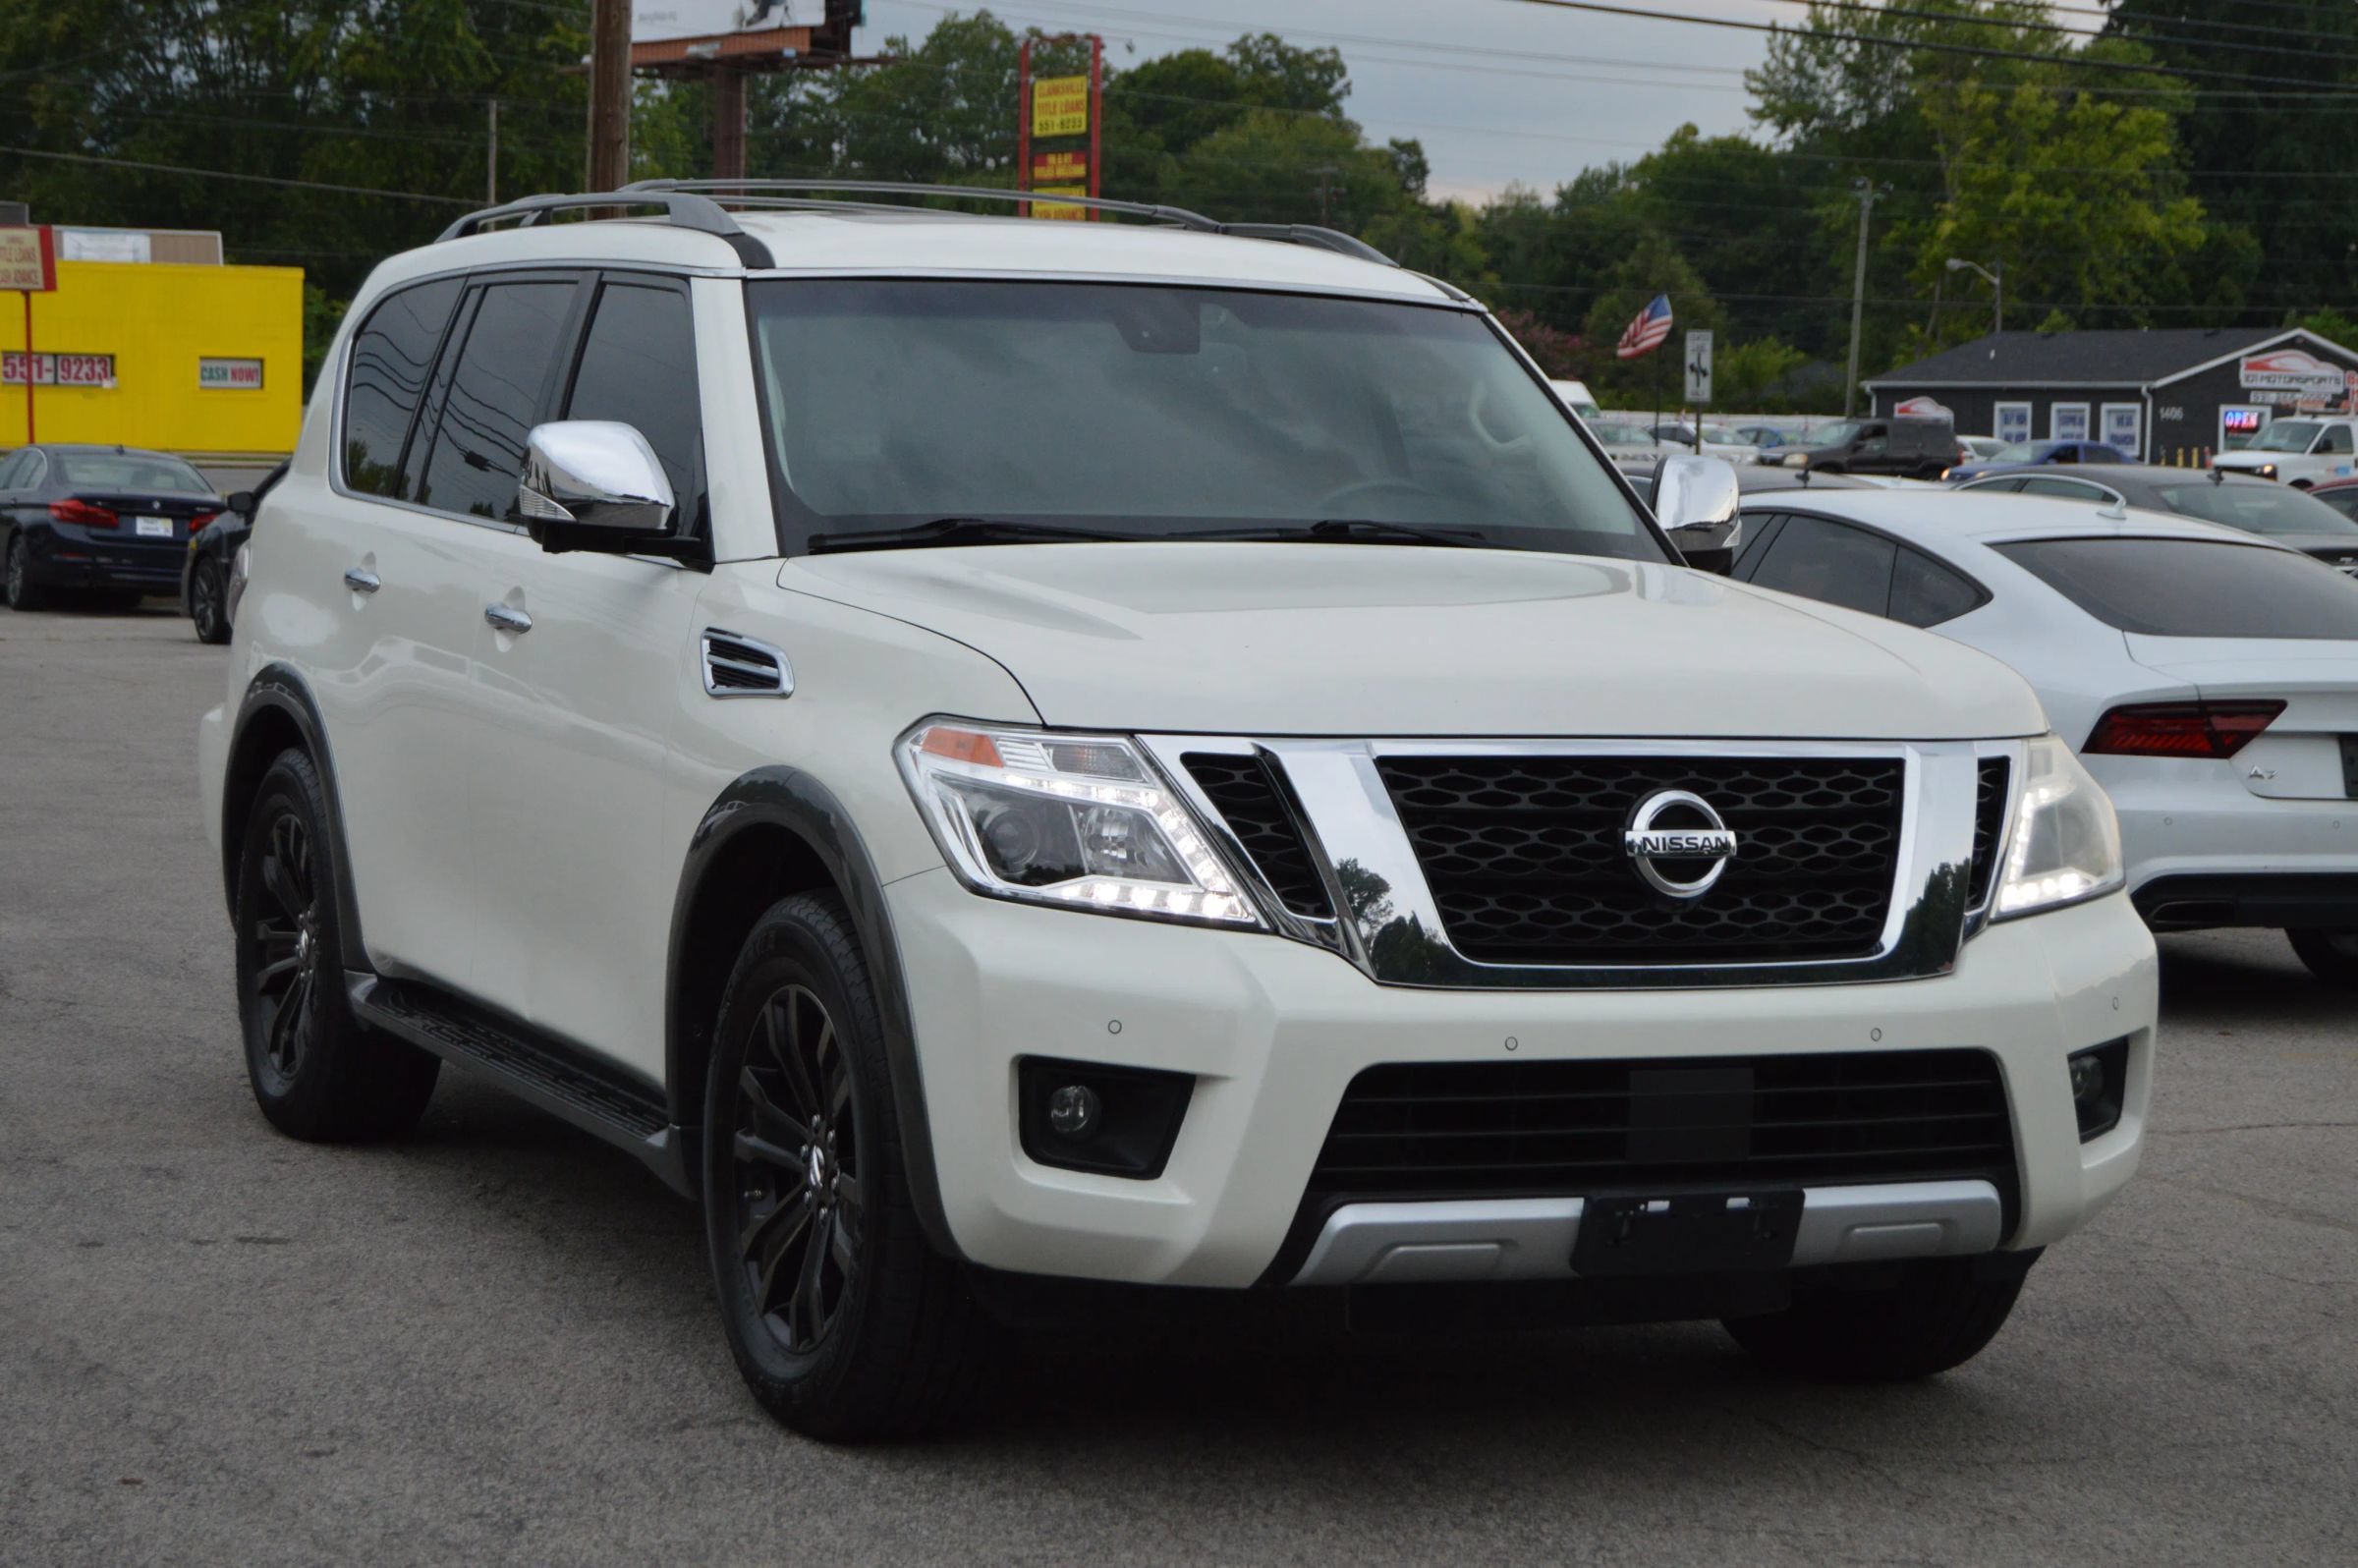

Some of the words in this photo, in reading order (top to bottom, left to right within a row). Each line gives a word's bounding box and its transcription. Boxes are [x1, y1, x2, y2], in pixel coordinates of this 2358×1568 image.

[200, 363, 228, 381] CASH
[231, 363, 259, 382] NOW!
[2225, 412, 2259, 428] OPEN
[1643, 836, 1729, 853] NISSAN
